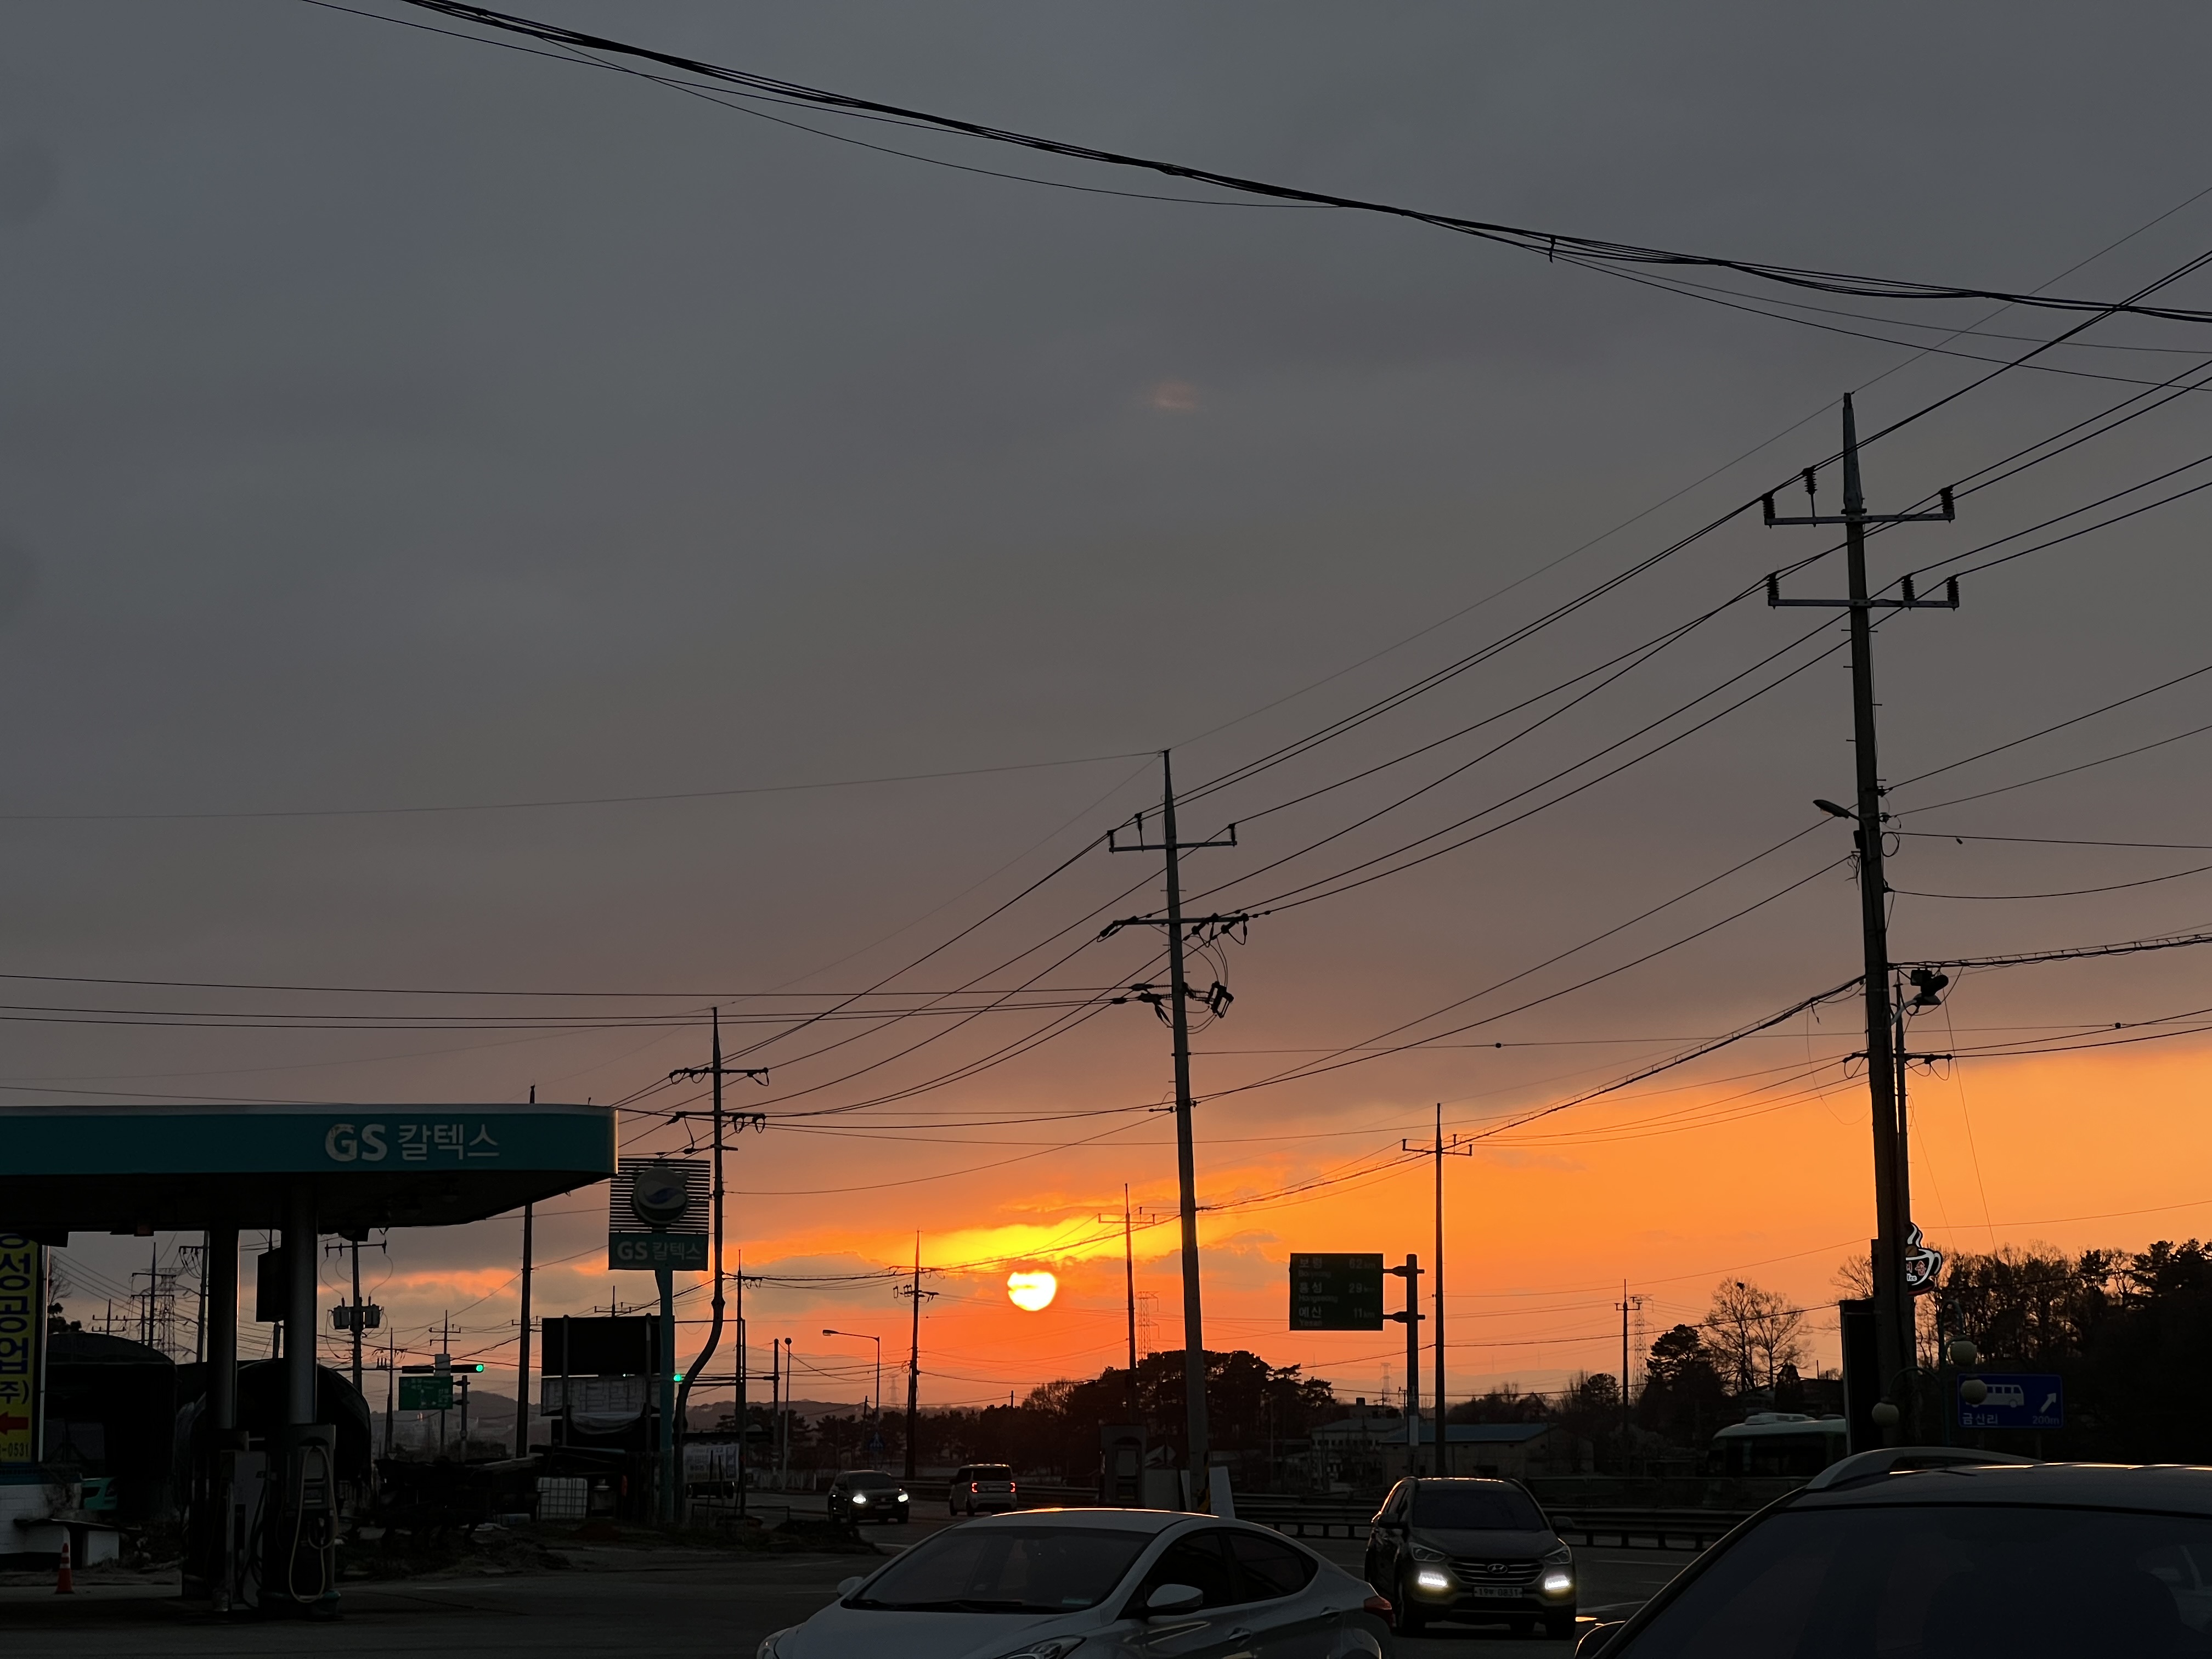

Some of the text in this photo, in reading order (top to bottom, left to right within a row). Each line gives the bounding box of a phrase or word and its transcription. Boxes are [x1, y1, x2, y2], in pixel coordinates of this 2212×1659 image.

[324, 1123, 500, 1162] GS 칼텍스
[617, 1241, 702, 1260] GS 칼텍스
[1299, 1257, 1323, 1268] 보령
[1299, 1282, 1322, 1294] 홍성
[1299, 1306, 1322, 1318] 예산
[1962, 1413, 2060, 1425] 금산리 200m
[0, 1443, 28, 1458] -0531
